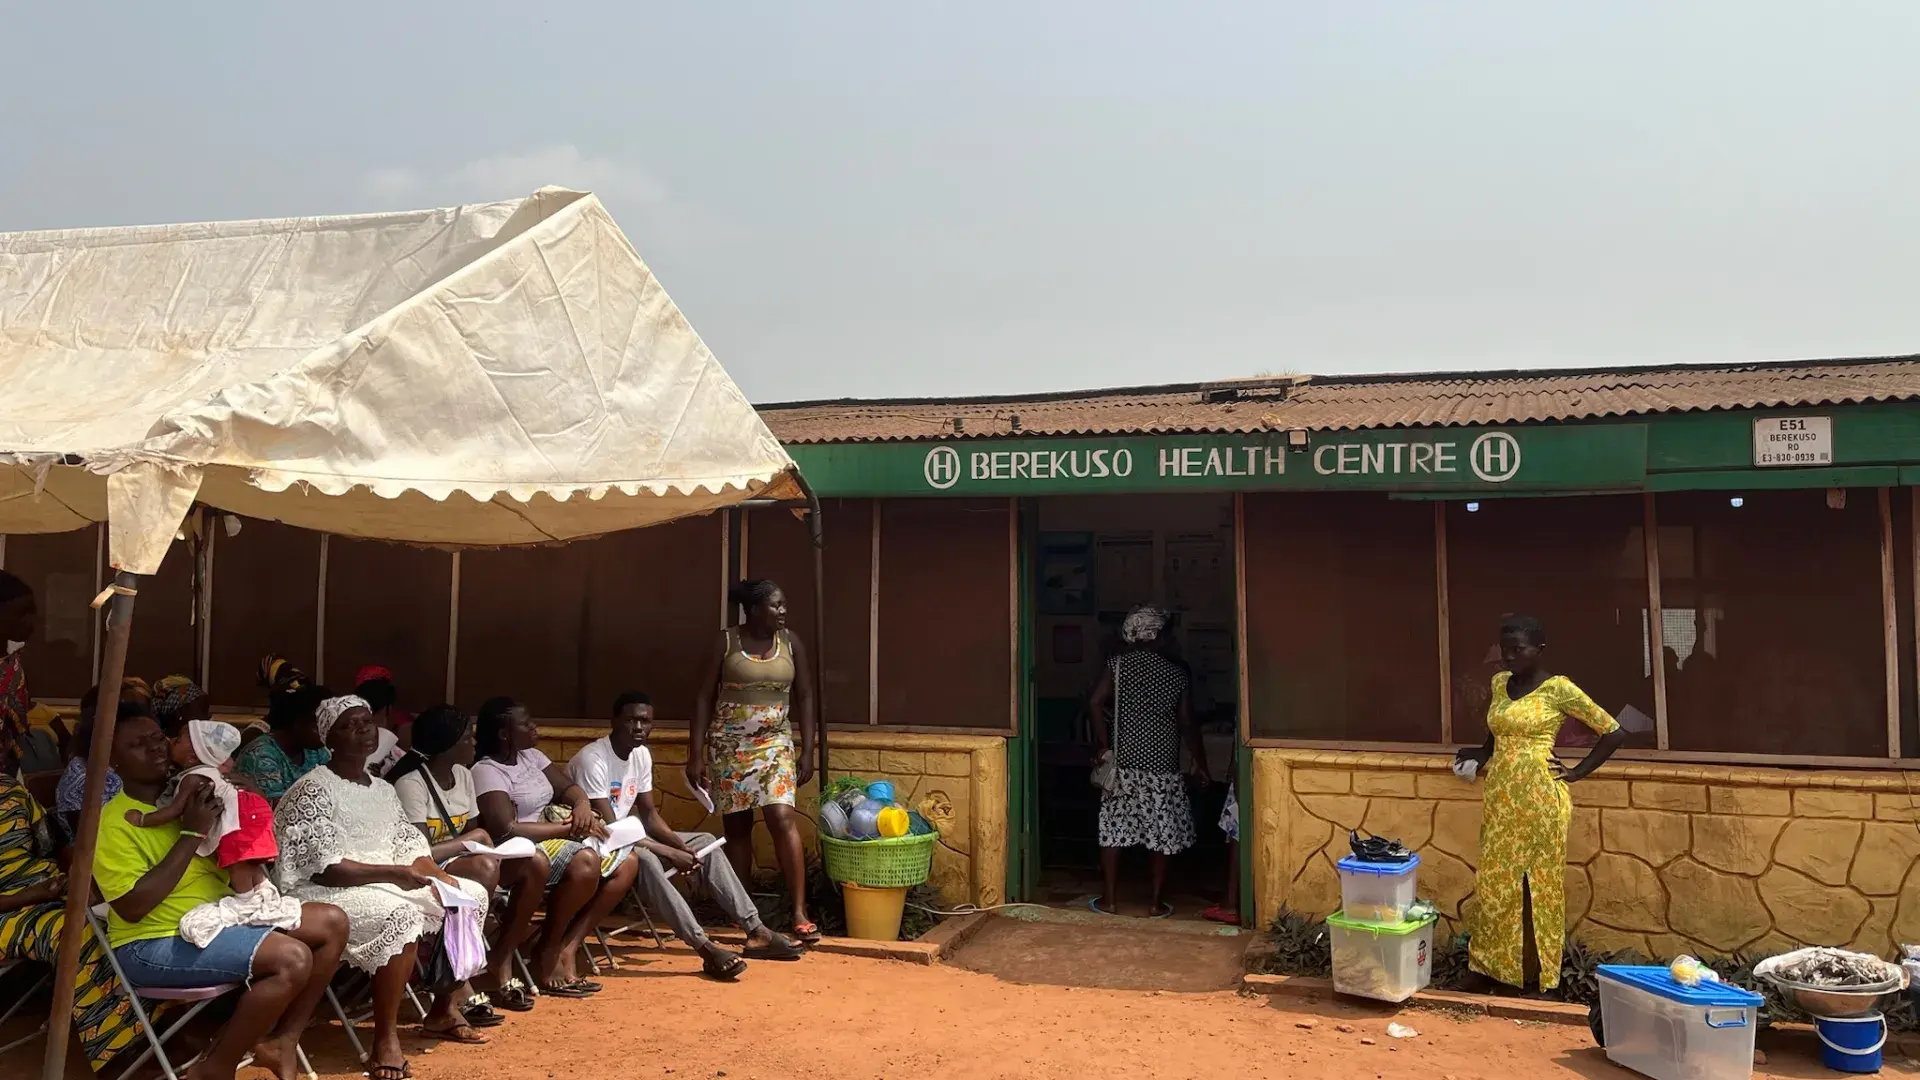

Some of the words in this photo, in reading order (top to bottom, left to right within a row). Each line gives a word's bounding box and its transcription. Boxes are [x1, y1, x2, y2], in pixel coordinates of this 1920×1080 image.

[1780, 420, 1806, 430] E51
[1770, 433, 1817, 442] BEREKUSO
[1788, 443, 1799, 451] RD
[971, 449, 1133, 479] BEREKUSO
[1159, 446, 1285, 476] HEALTH
[1313, 442, 1457, 475] CENTRE
